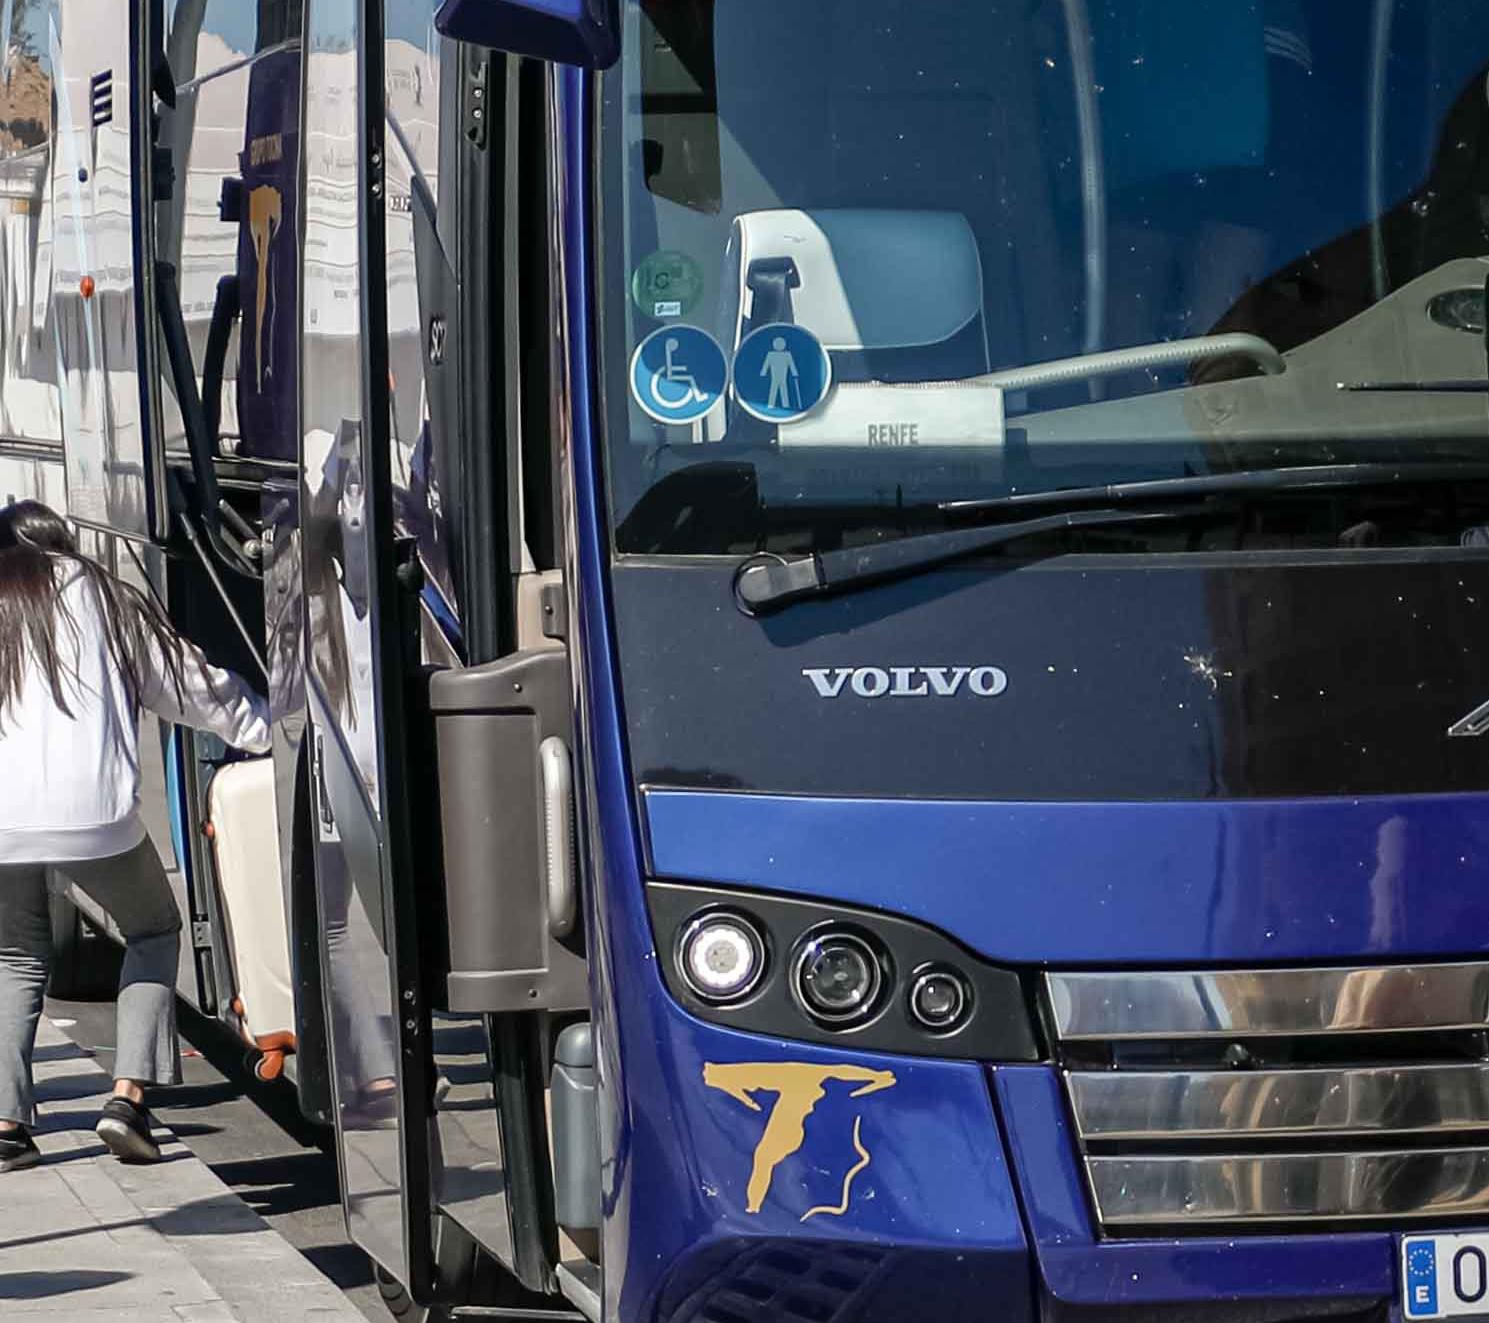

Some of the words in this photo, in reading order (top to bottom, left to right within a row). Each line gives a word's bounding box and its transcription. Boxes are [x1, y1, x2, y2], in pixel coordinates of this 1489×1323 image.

[867, 423, 919, 447] RENFE
[802, 666, 1008, 698] VOLVO
[1415, 1285, 1430, 1303] E
